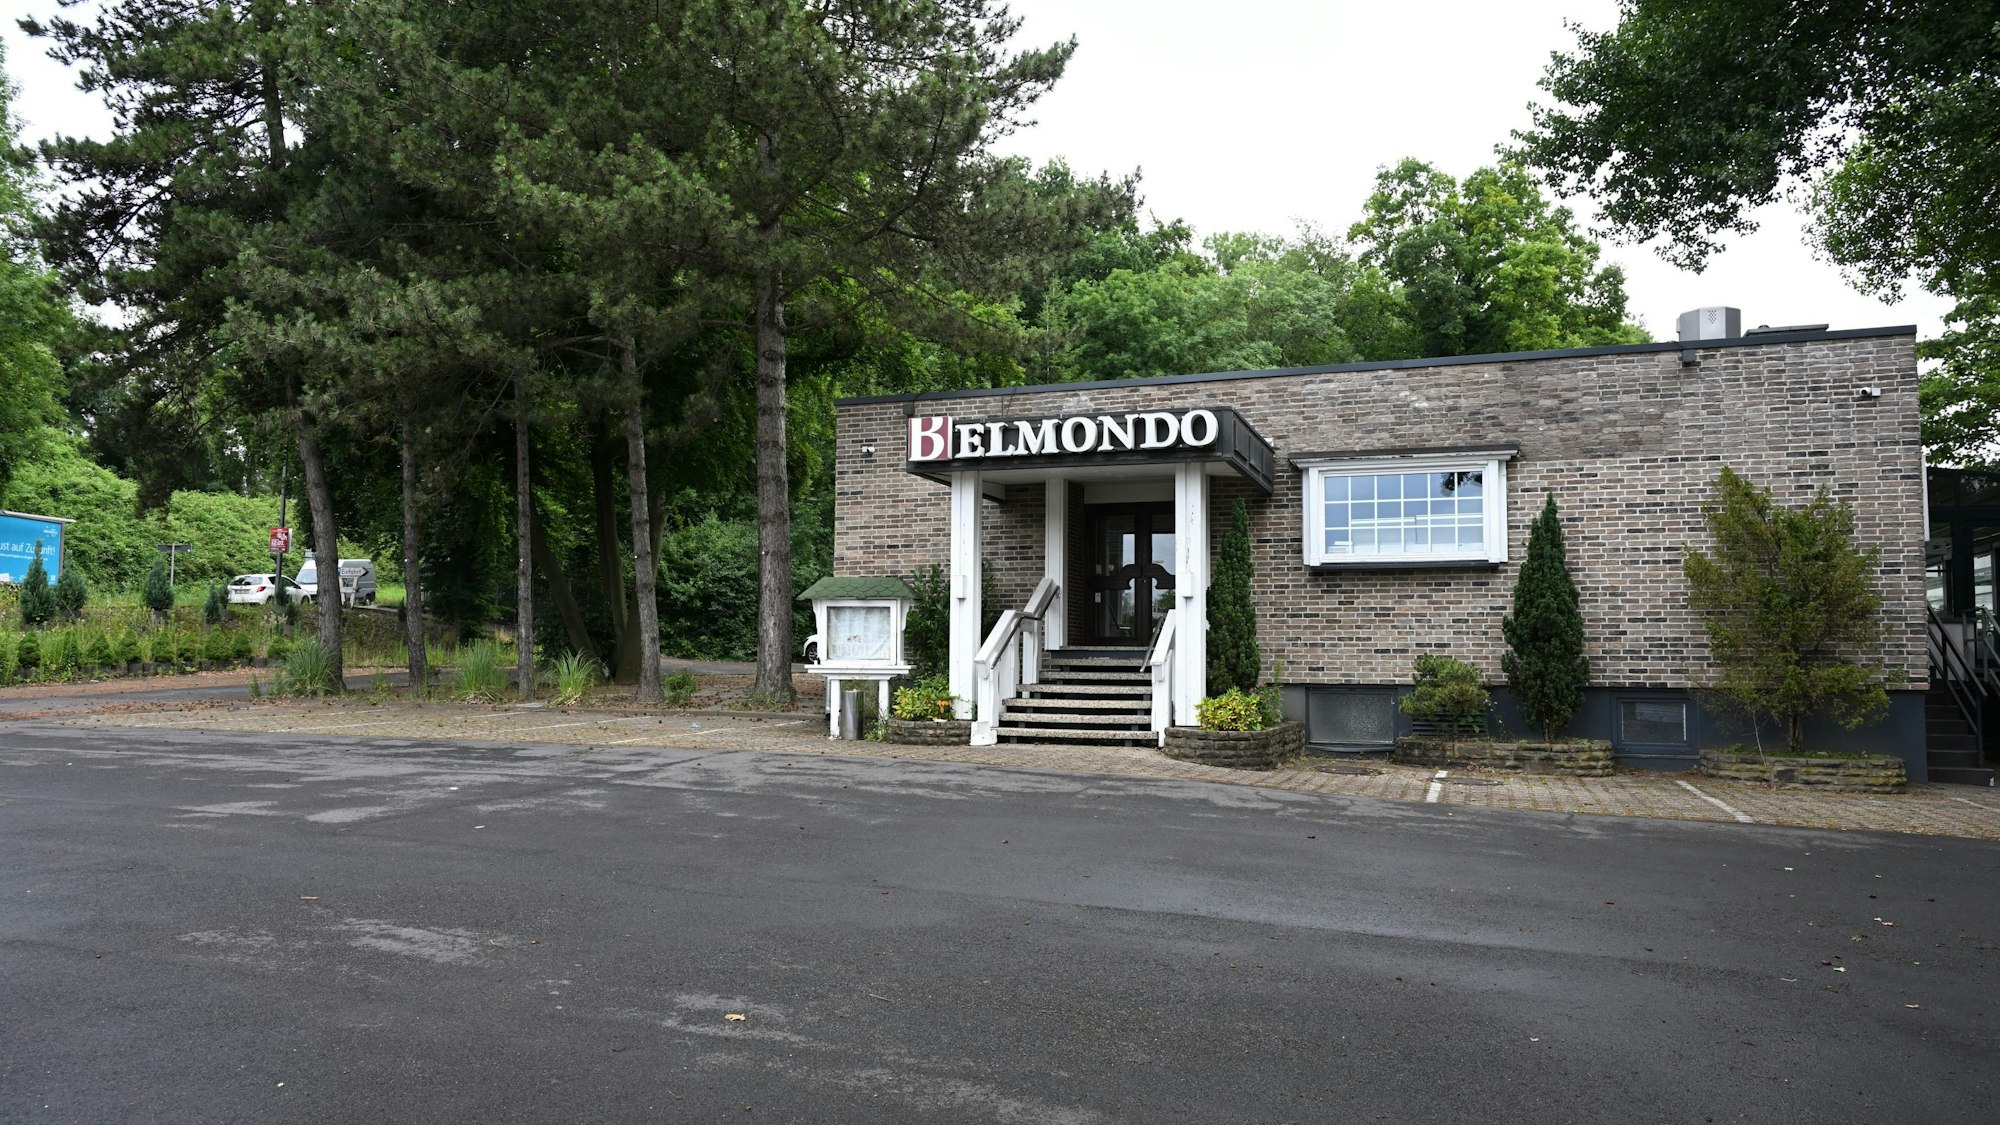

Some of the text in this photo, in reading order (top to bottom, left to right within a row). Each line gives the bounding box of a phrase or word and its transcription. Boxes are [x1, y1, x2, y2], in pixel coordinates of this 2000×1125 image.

[909, 409, 1219, 461] BELMONDO
[11, 542, 24, 552] auf
[25, 543, 56, 556] Zuunft!
